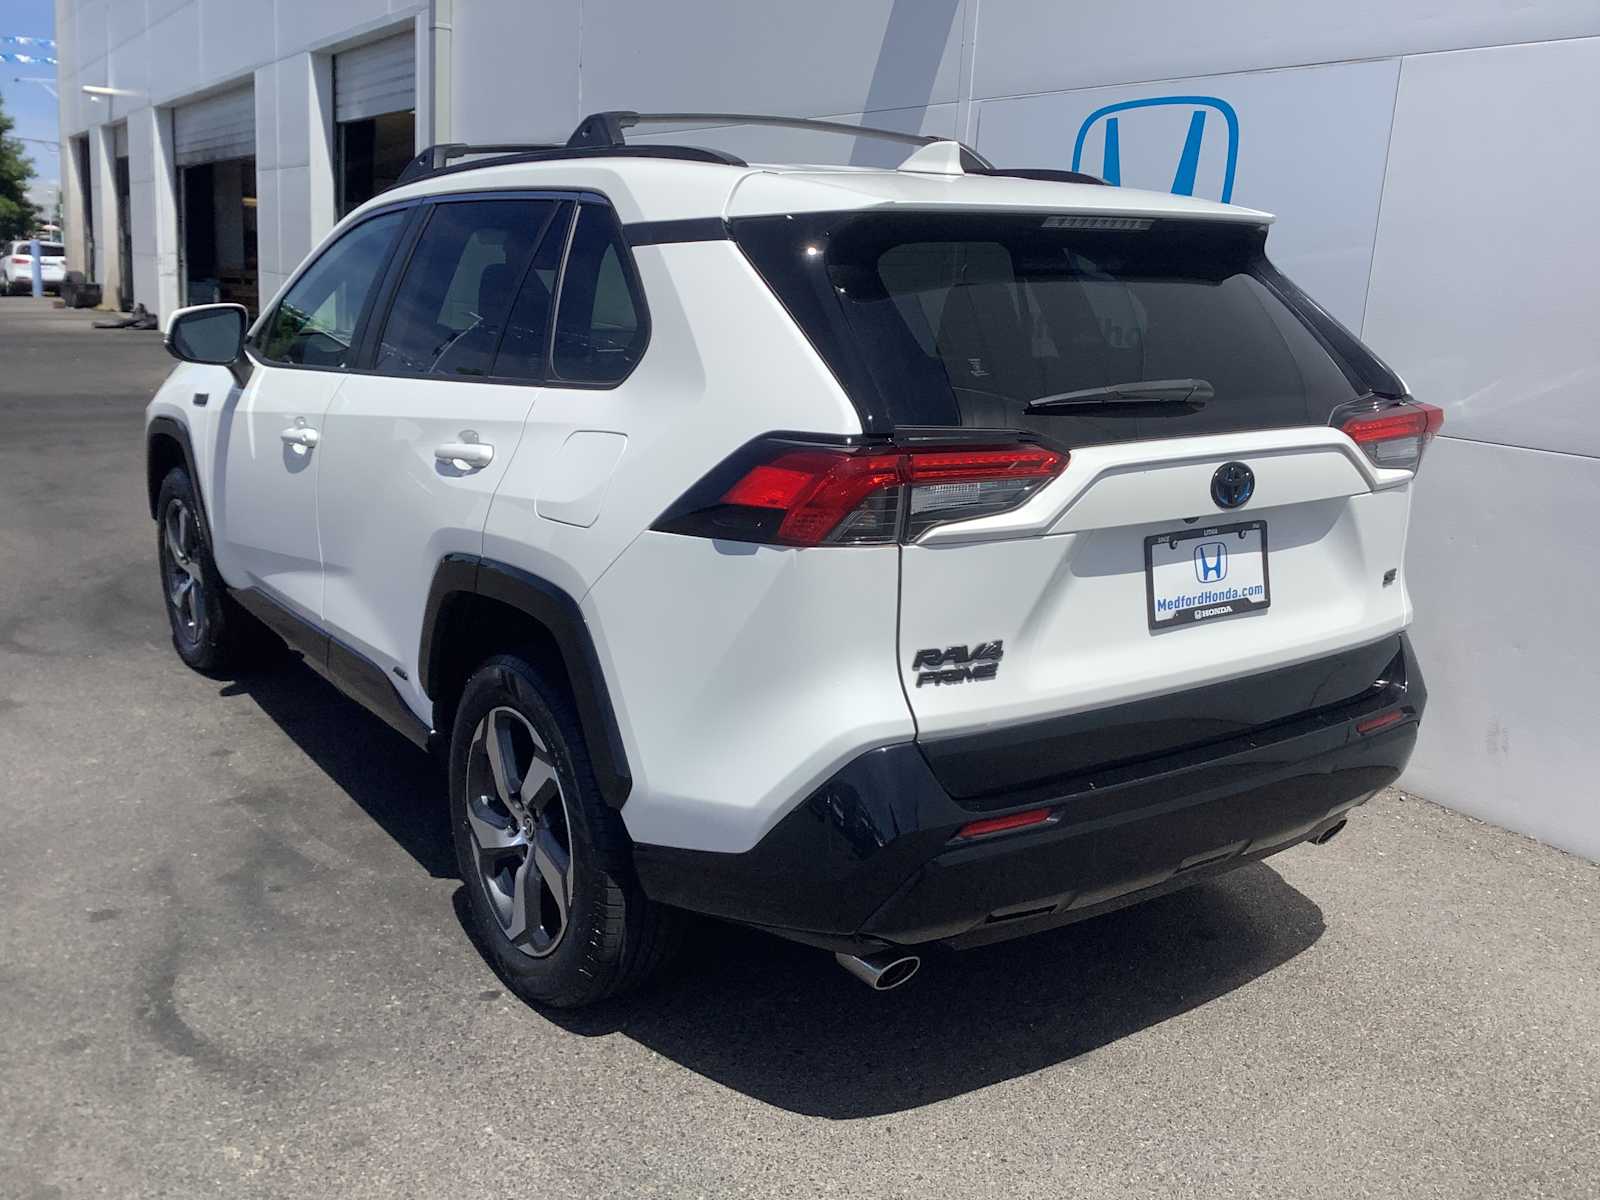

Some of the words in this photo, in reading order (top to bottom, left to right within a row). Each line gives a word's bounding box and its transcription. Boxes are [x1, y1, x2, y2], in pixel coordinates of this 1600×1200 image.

[1157, 584, 1263, 612] MedfordHonda.com
[1202, 606, 1233, 617] HONDA
[912, 640, 1003, 671] RAV4
